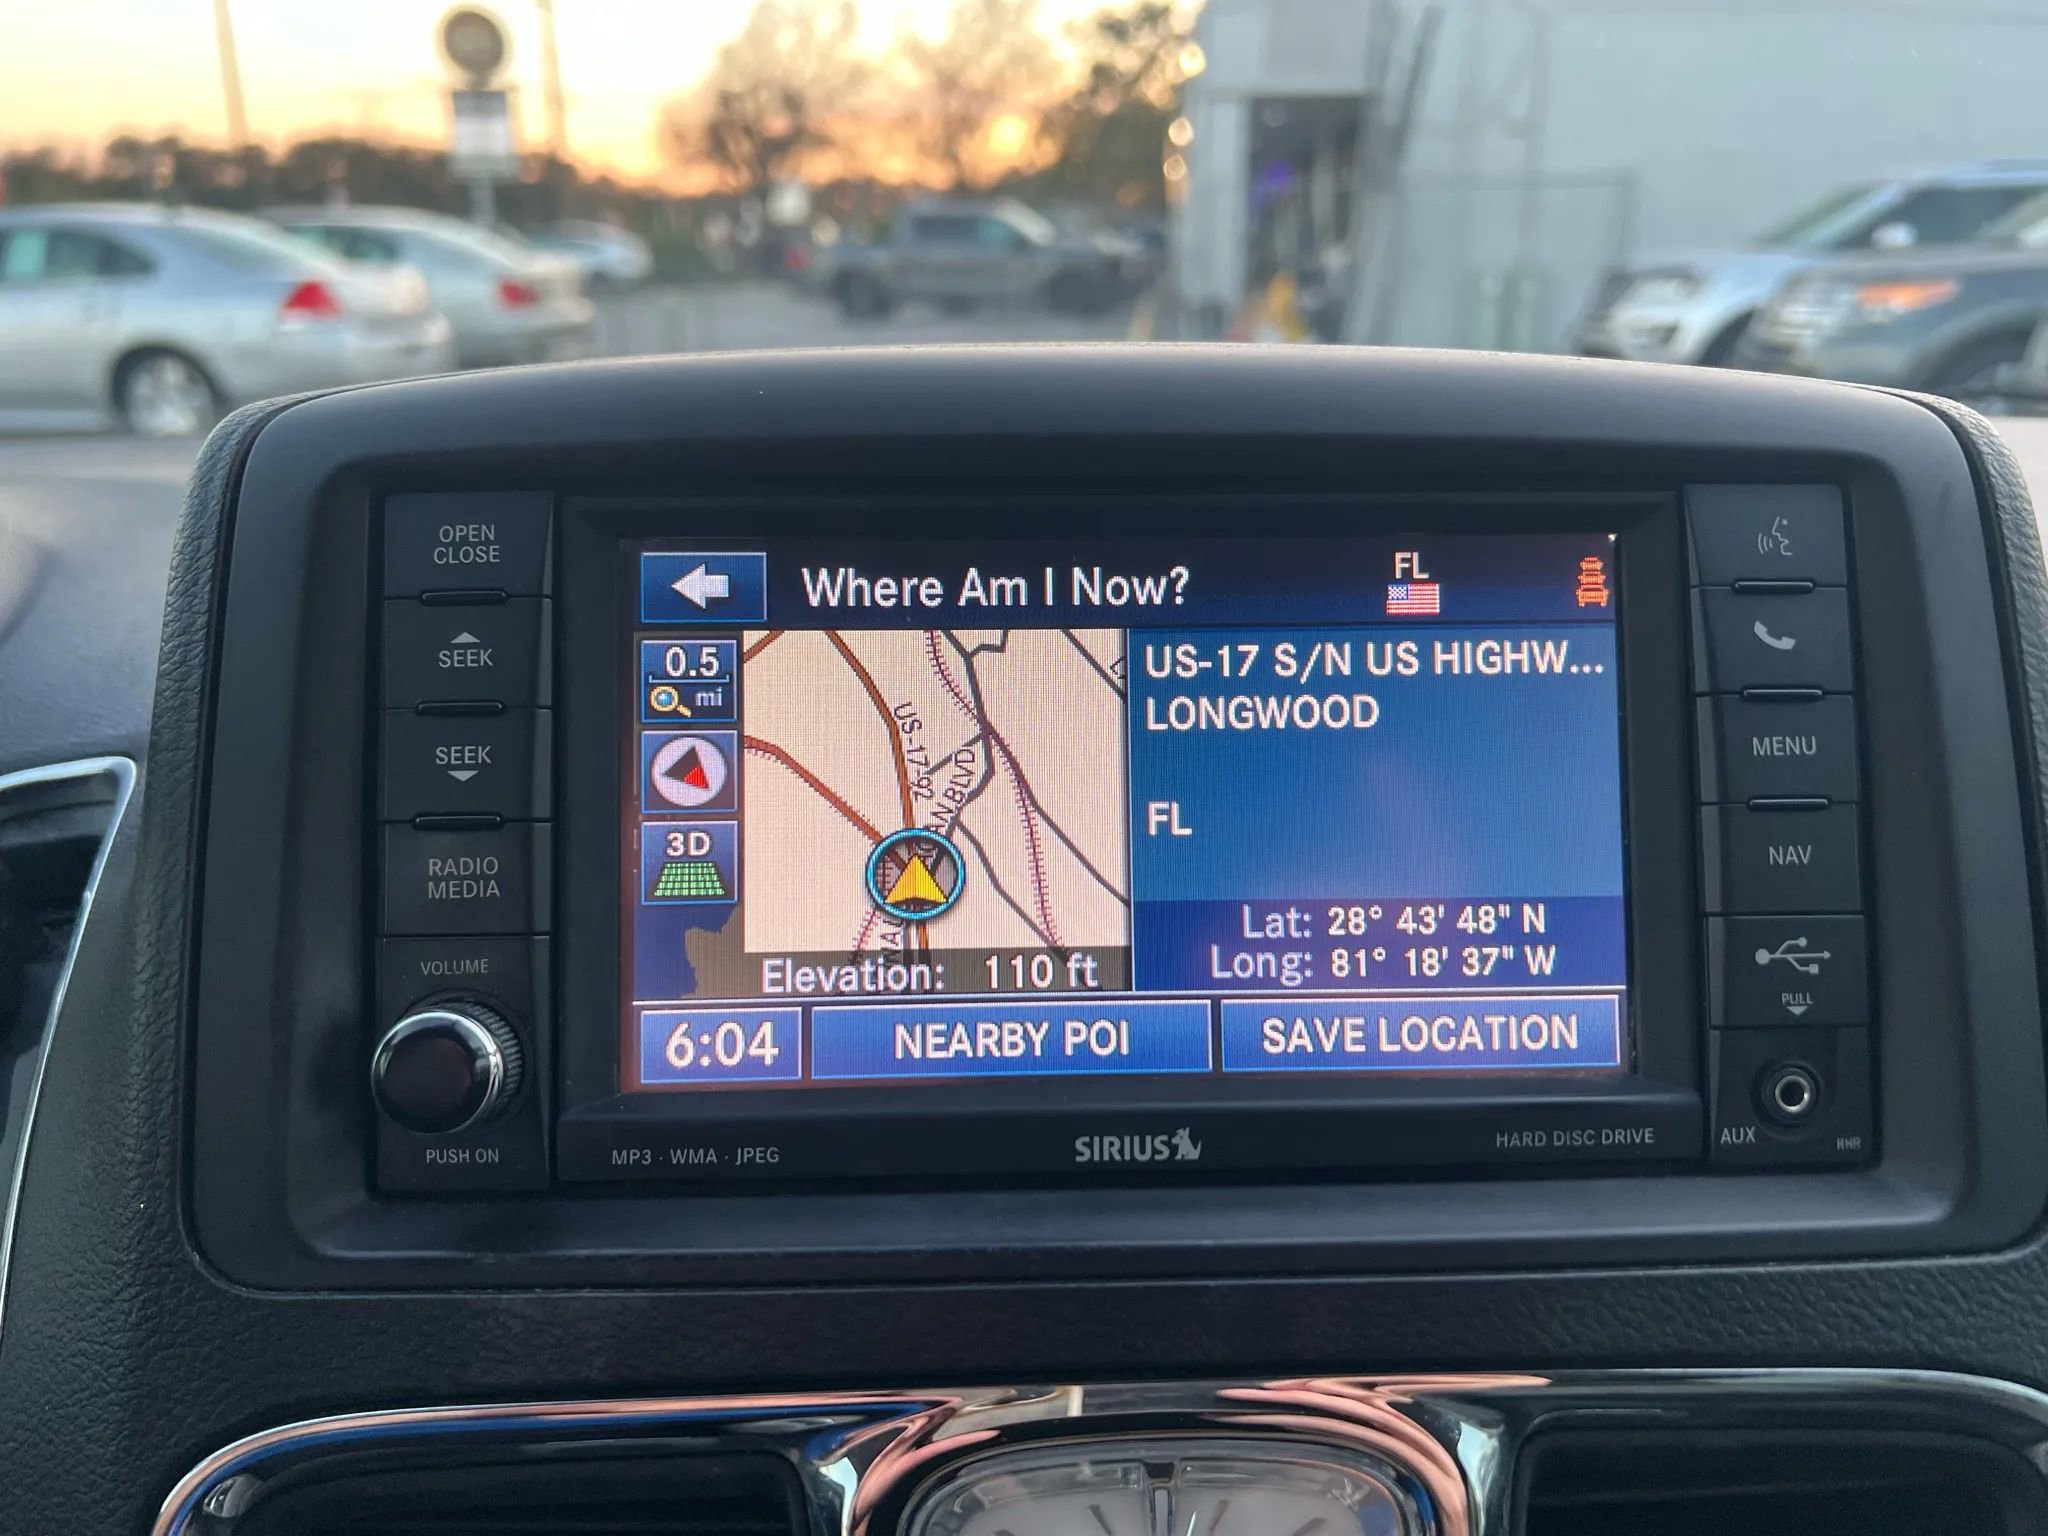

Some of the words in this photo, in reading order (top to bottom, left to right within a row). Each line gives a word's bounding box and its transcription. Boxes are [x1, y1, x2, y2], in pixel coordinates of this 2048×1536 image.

[438, 524, 496, 543] OPEN
[433, 546, 501, 565] CLOSE
[1394, 551, 1430, 580] FL
[801, 567, 944, 607] Where
[957, 566, 1029, 607] Am
[1043, 566, 1054, 607] I
[1071, 565, 1190, 606] Now?
[437, 648, 494, 669] SEEK
[664, 646, 720, 678] 0.5
[1144, 643, 1260, 679] US-17
[1274, 641, 1352, 684] S/N
[1366, 640, 1420, 677] US
[695, 686, 723, 707] mi
[1145, 693, 1380, 732] LONGWOOD
[434, 745, 493, 765] SEEK
[1752, 735, 1818, 757] MENU
[1147, 800, 1194, 837] FL
[665, 831, 711, 858] 3D
[1767, 844, 1813, 867] NAV
[427, 856, 499, 877] RADIO
[427, 879, 501, 900] MEDIA
[1242, 903, 1312, 939] Lat:
[1327, 904, 1383, 937] 28°
[1522, 902, 1547, 935] N
[420, 959, 490, 976] VOLUME
[761, 956, 945, 993] Elevation:
[984, 955, 1053, 989] 110
[1066, 954, 1100, 989] ft
[1211, 943, 1313, 986] Long:
[1331, 948, 1387, 978] 81°
[1526, 943, 1557, 977] W
[1781, 993, 1814, 1005] PULL
[664, 1021, 780, 1070] 6:04
[894, 1021, 1049, 1060] NEARBY
[1064, 1018, 1130, 1057] POI
[1262, 1016, 1367, 1055] SAVE
[1378, 1014, 1580, 1053] LOCATION
[1495, 1130, 1547, 1149] HARD
[1552, 1129, 1595, 1147] DISC
[1600, 1127, 1656, 1146] DRIVE
[1719, 1126, 1757, 1145] AUX
[425, 1148, 471, 1165] PUSH
[474, 1147, 500, 1164] ON
[611, 1149, 652, 1166] MP3
[669, 1149, 718, 1166] WMA
[735, 1147, 781, 1165] JPEG
[1074, 1133, 1170, 1163] SIRIUS
